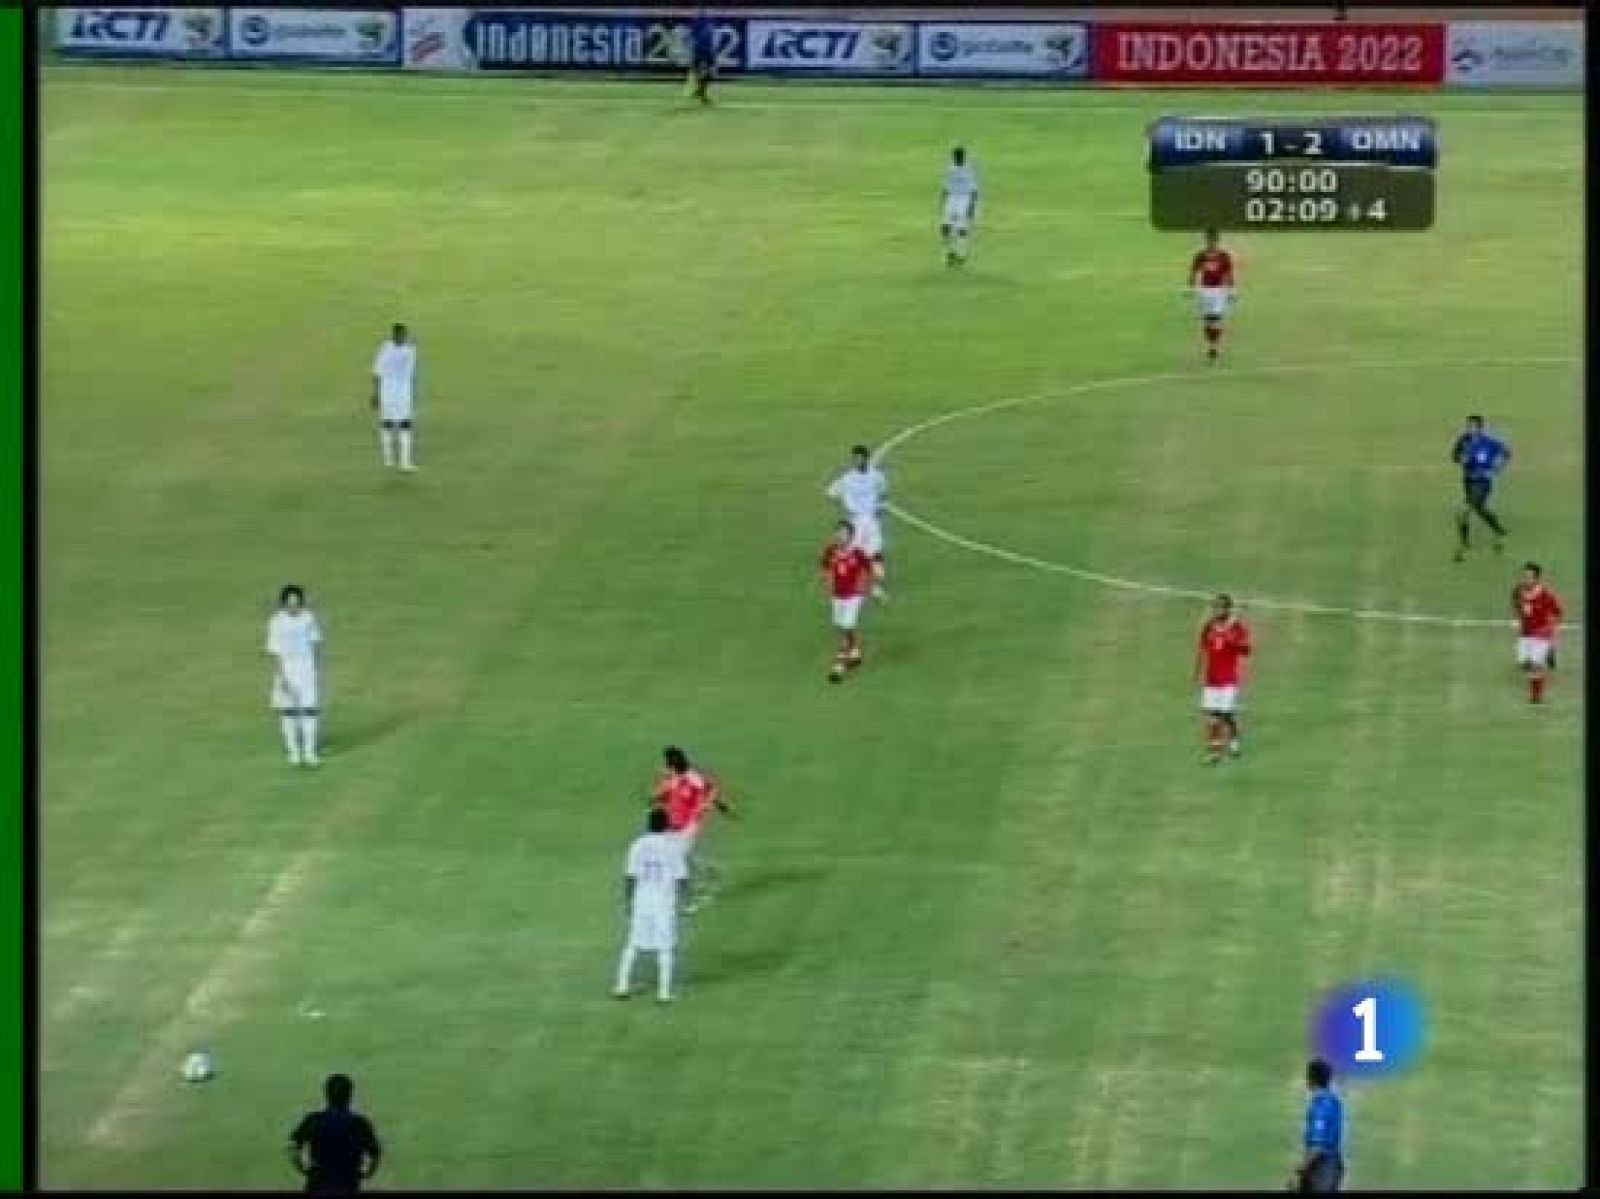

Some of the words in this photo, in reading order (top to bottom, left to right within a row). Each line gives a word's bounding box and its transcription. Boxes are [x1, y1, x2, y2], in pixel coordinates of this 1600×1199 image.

[70, 12, 169, 42] RCTI
[762, 29, 860, 59] RCTI
[1117, 32, 1325, 71] INDONESIA
[1337, 35, 1423, 71] 2022
